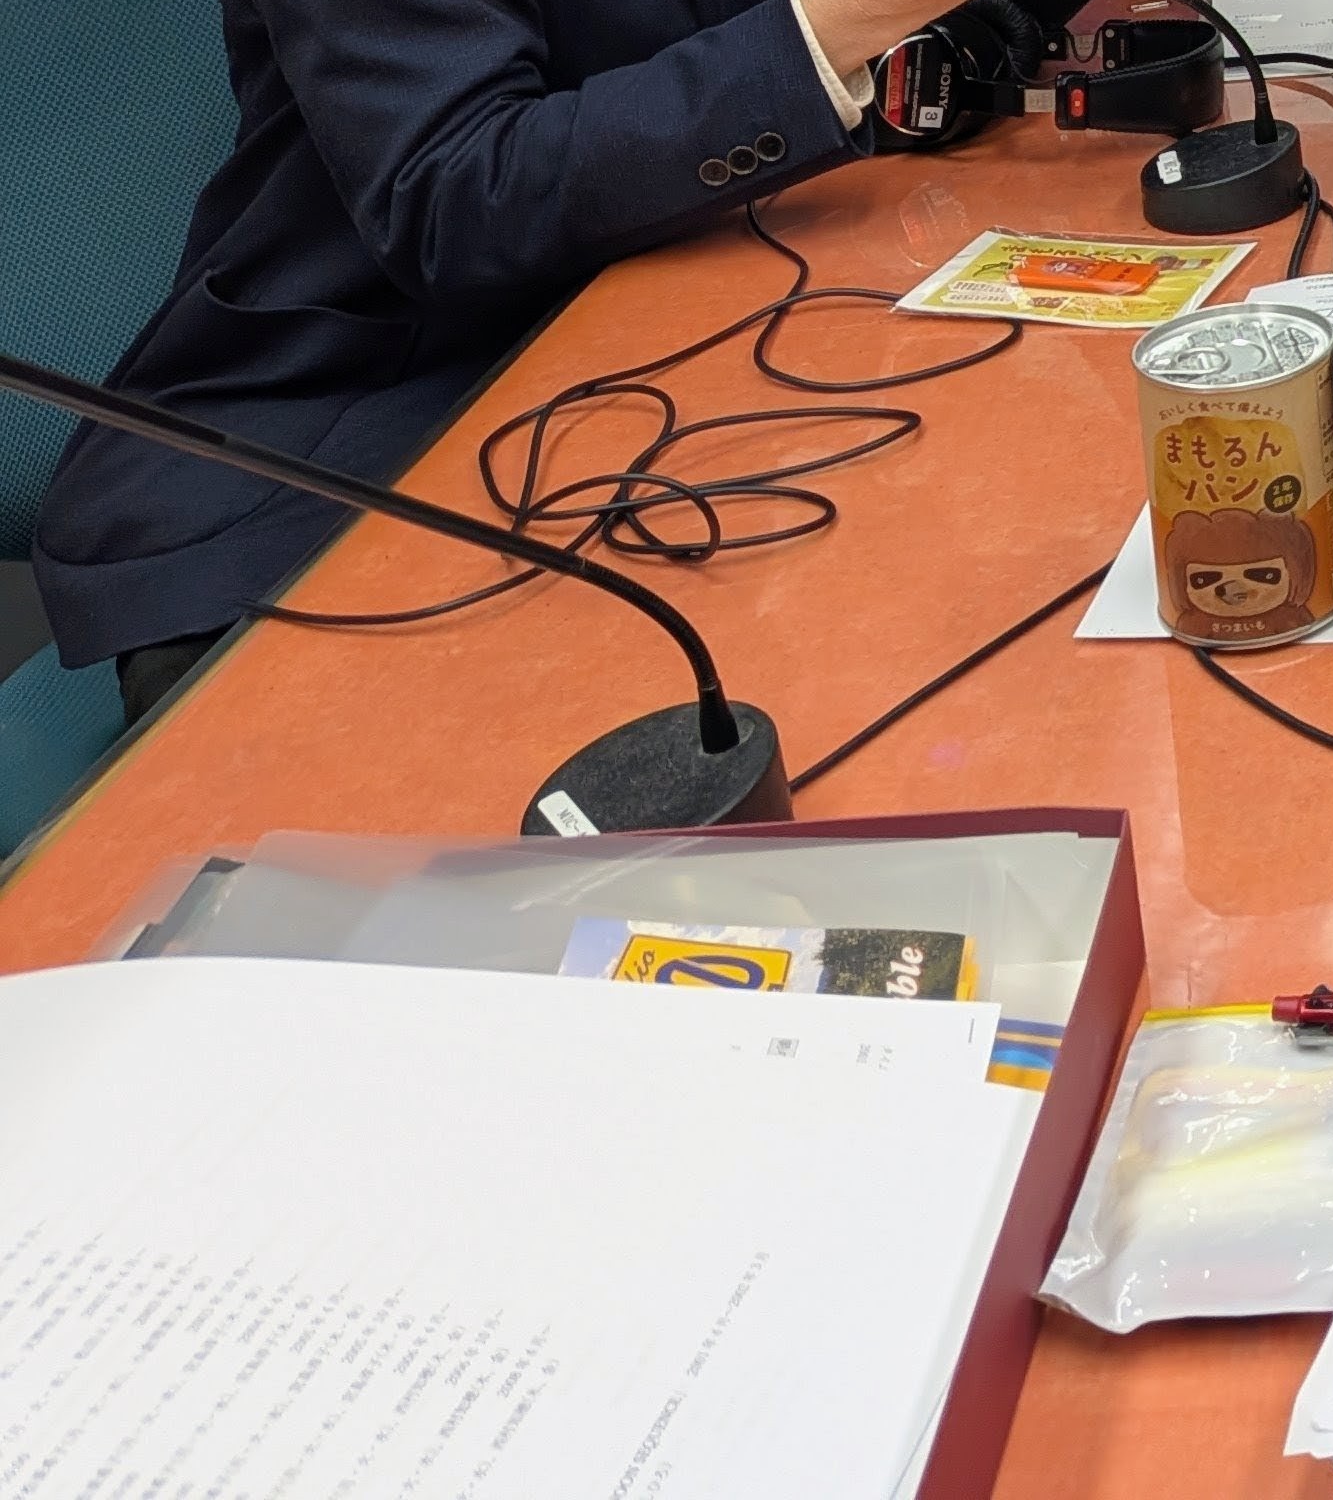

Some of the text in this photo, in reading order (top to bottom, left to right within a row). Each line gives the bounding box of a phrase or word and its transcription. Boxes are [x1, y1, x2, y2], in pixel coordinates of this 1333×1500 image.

[939, 62, 951, 111] SONY
[924, 110, 938, 122] 3
[1158, 400, 1285, 422] おいしく食べて備えよう
[1165, 431, 1282, 468] まもるん
[1184, 472, 1260, 502] パン
[1211, 620, 1266, 633] さつまいも
